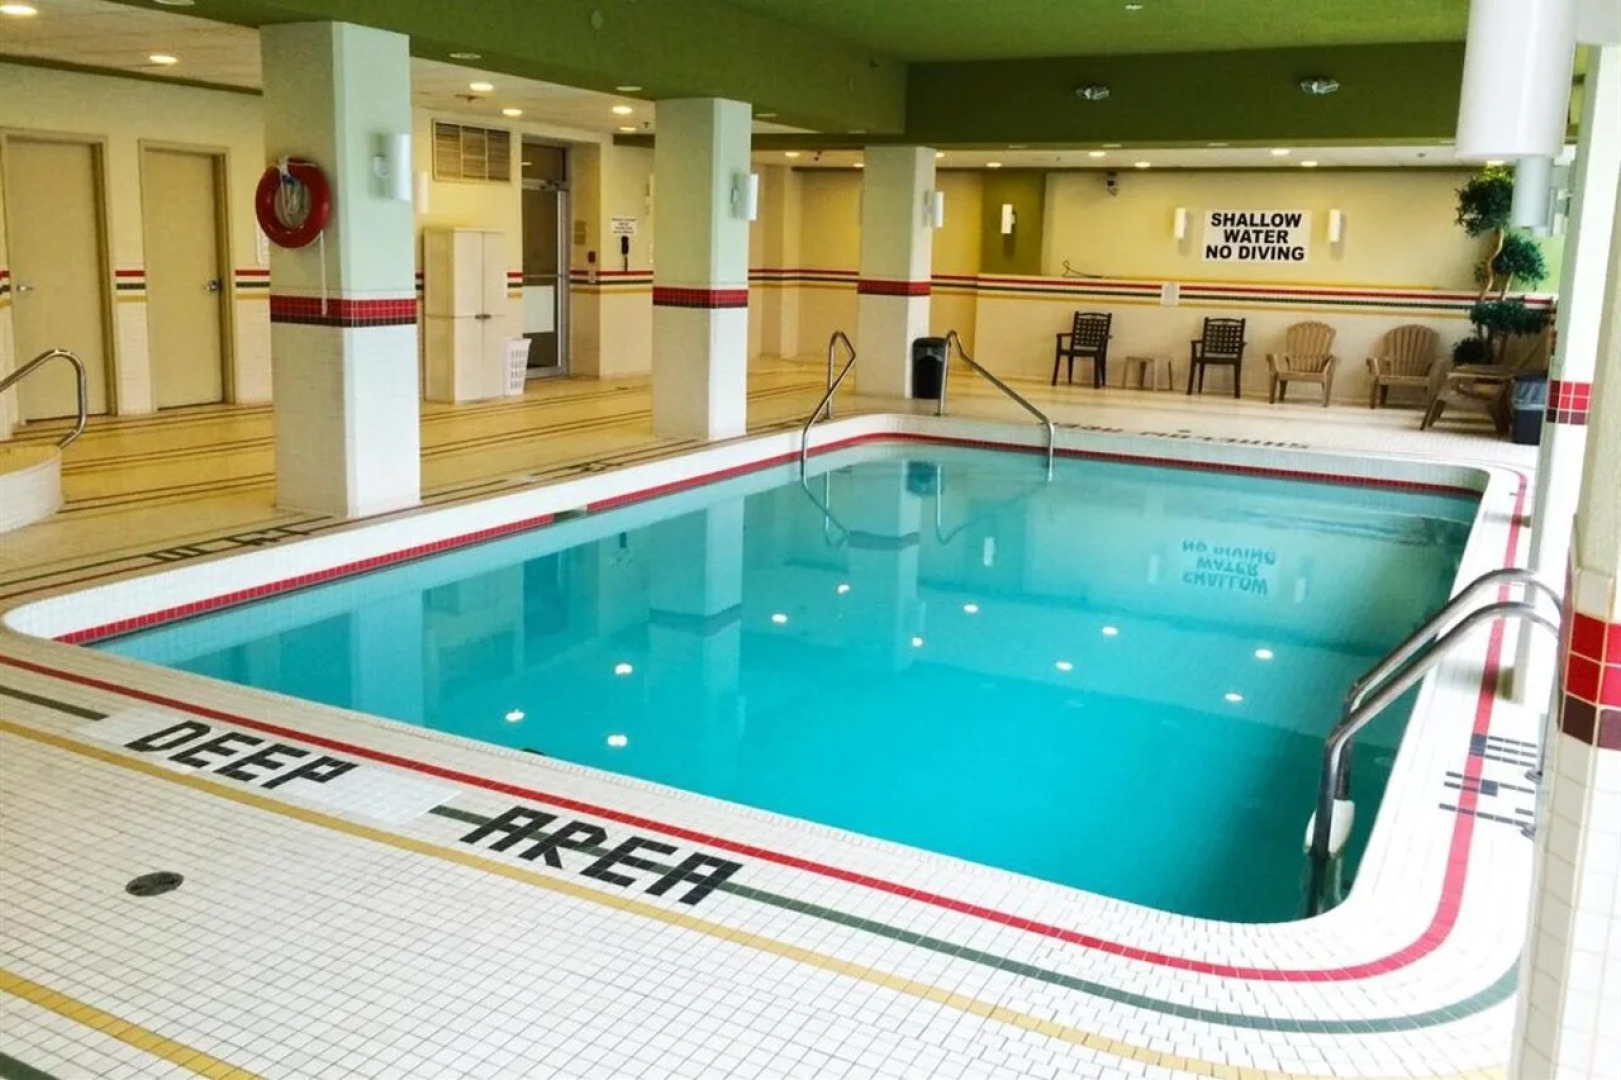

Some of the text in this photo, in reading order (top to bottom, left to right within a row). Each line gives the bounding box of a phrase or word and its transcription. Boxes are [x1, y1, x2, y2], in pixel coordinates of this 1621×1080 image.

[1211, 212, 1302, 228] SHALLOW
[1223, 229, 1289, 244] WATER
[1205, 245, 1305, 261] NO DIVING
[123, 720, 744, 906] DEEP AREA
